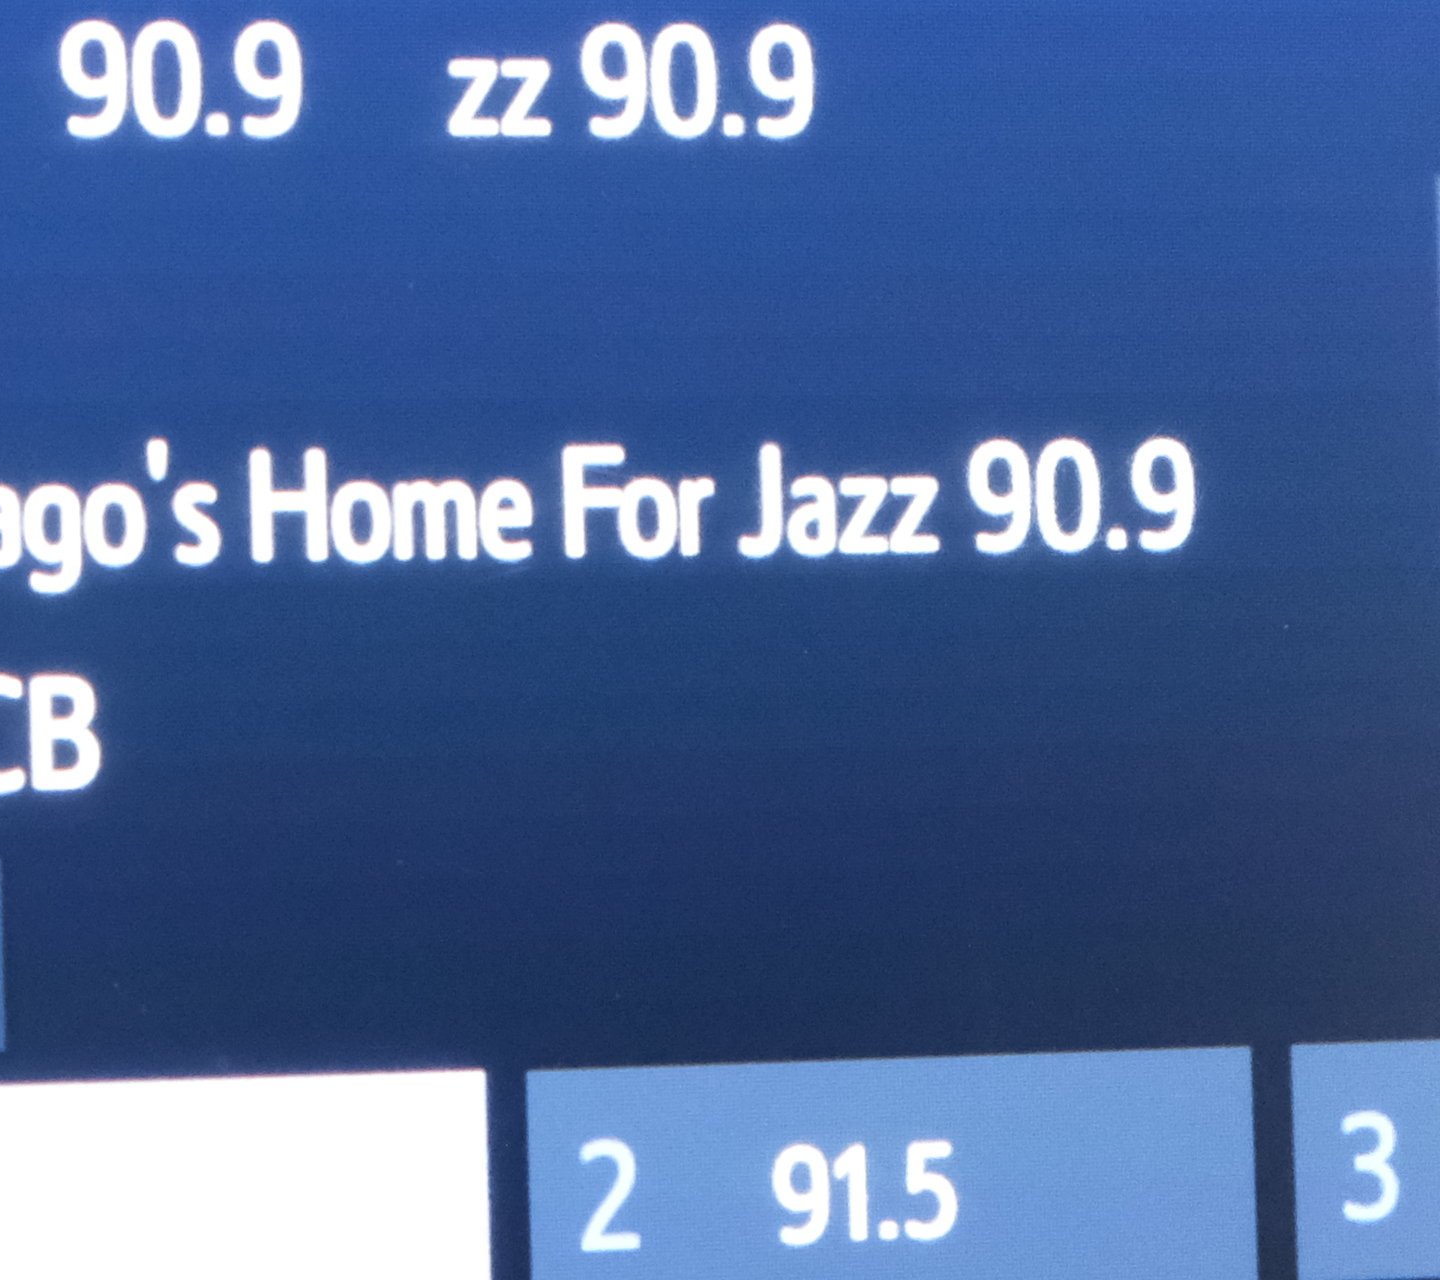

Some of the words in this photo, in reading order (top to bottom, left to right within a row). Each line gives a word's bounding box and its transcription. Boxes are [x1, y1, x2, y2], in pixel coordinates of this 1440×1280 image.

[57, 18, 305, 140] 90.9
[445, 56, 554, 139] zz
[578, 20, 817, 141] 90.9
[247, 445, 535, 566] Home
[560, 442, 717, 561] For
[736, 440, 942, 560] Jazz
[965, 435, 1198, 556] 90.9
[578, 1136, 642, 1253] 2
[770, 1138, 960, 1248] 91.5
[1341, 1108, 1401, 1223] 3
